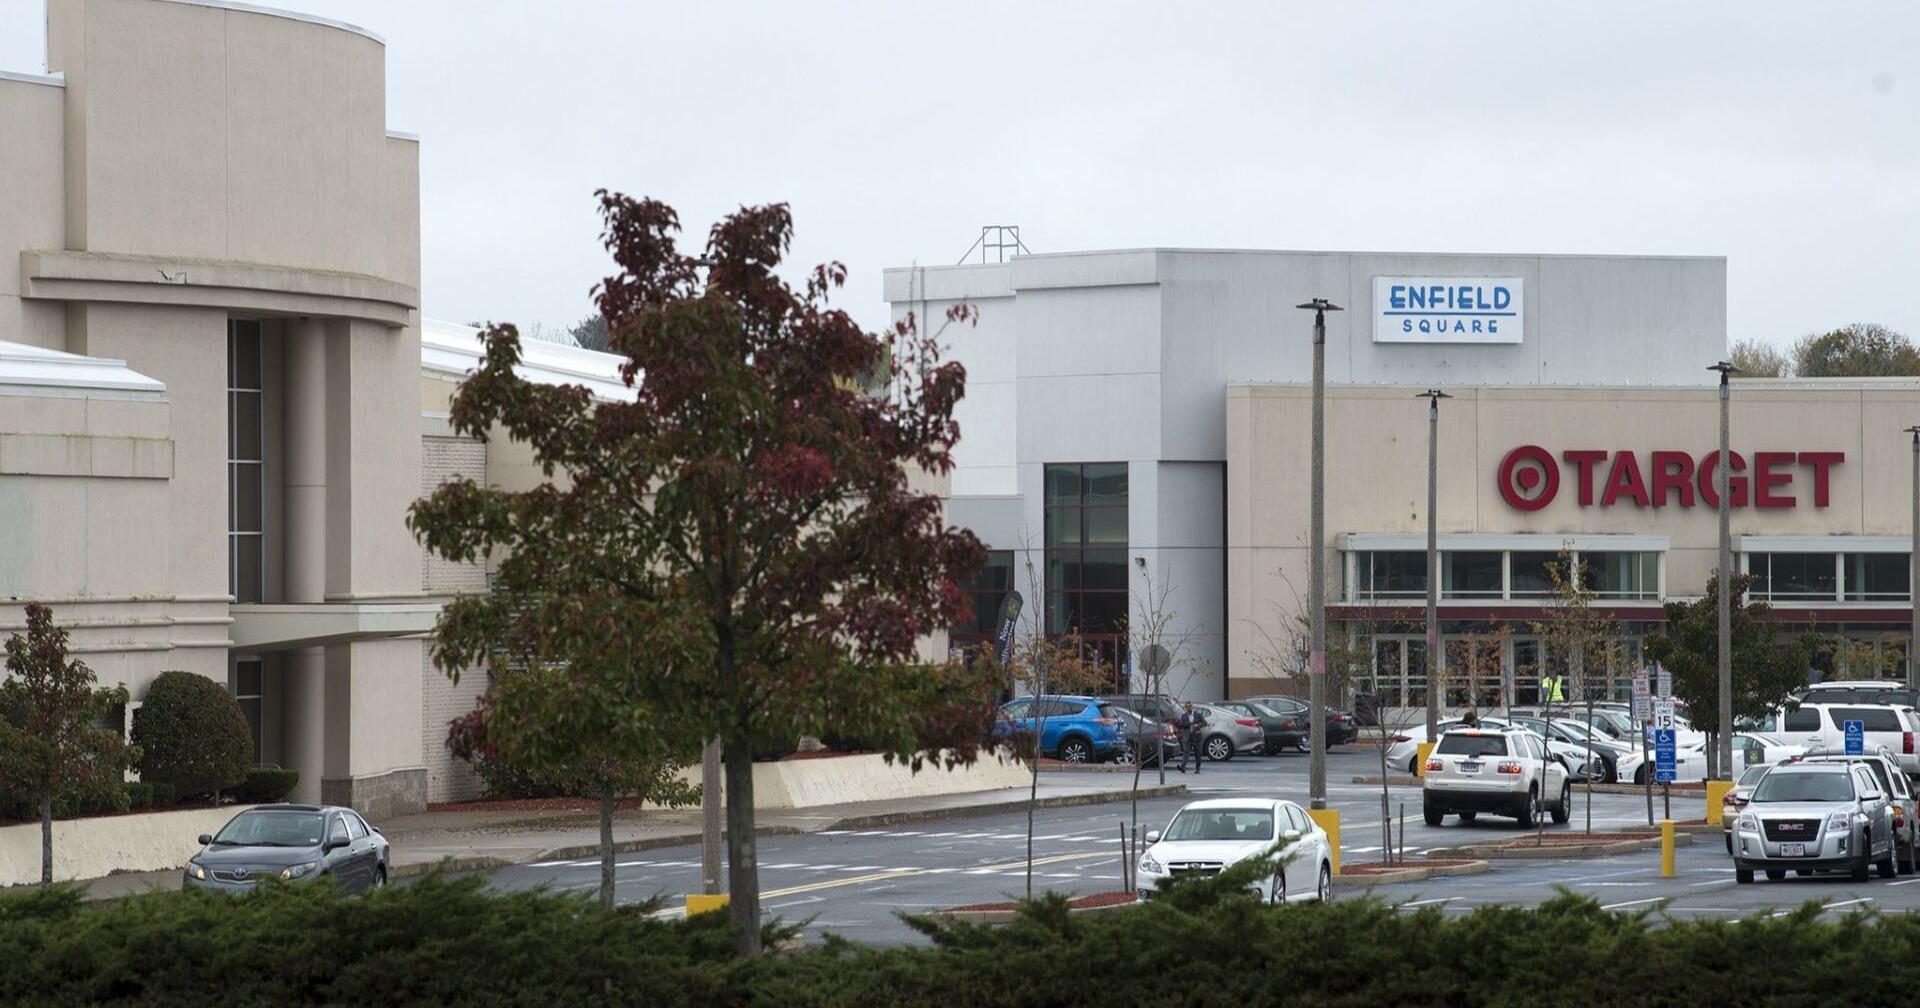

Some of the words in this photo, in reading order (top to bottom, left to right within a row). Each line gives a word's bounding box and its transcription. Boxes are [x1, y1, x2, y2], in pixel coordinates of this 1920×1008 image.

[1389, 285, 1511, 310] ENFIELD
[1402, 319, 1498, 334] SQUARE
[1563, 449, 1845, 508] TARGET
[1657, 715, 1671, 727] 15
[1778, 823, 1805, 831] GMC
